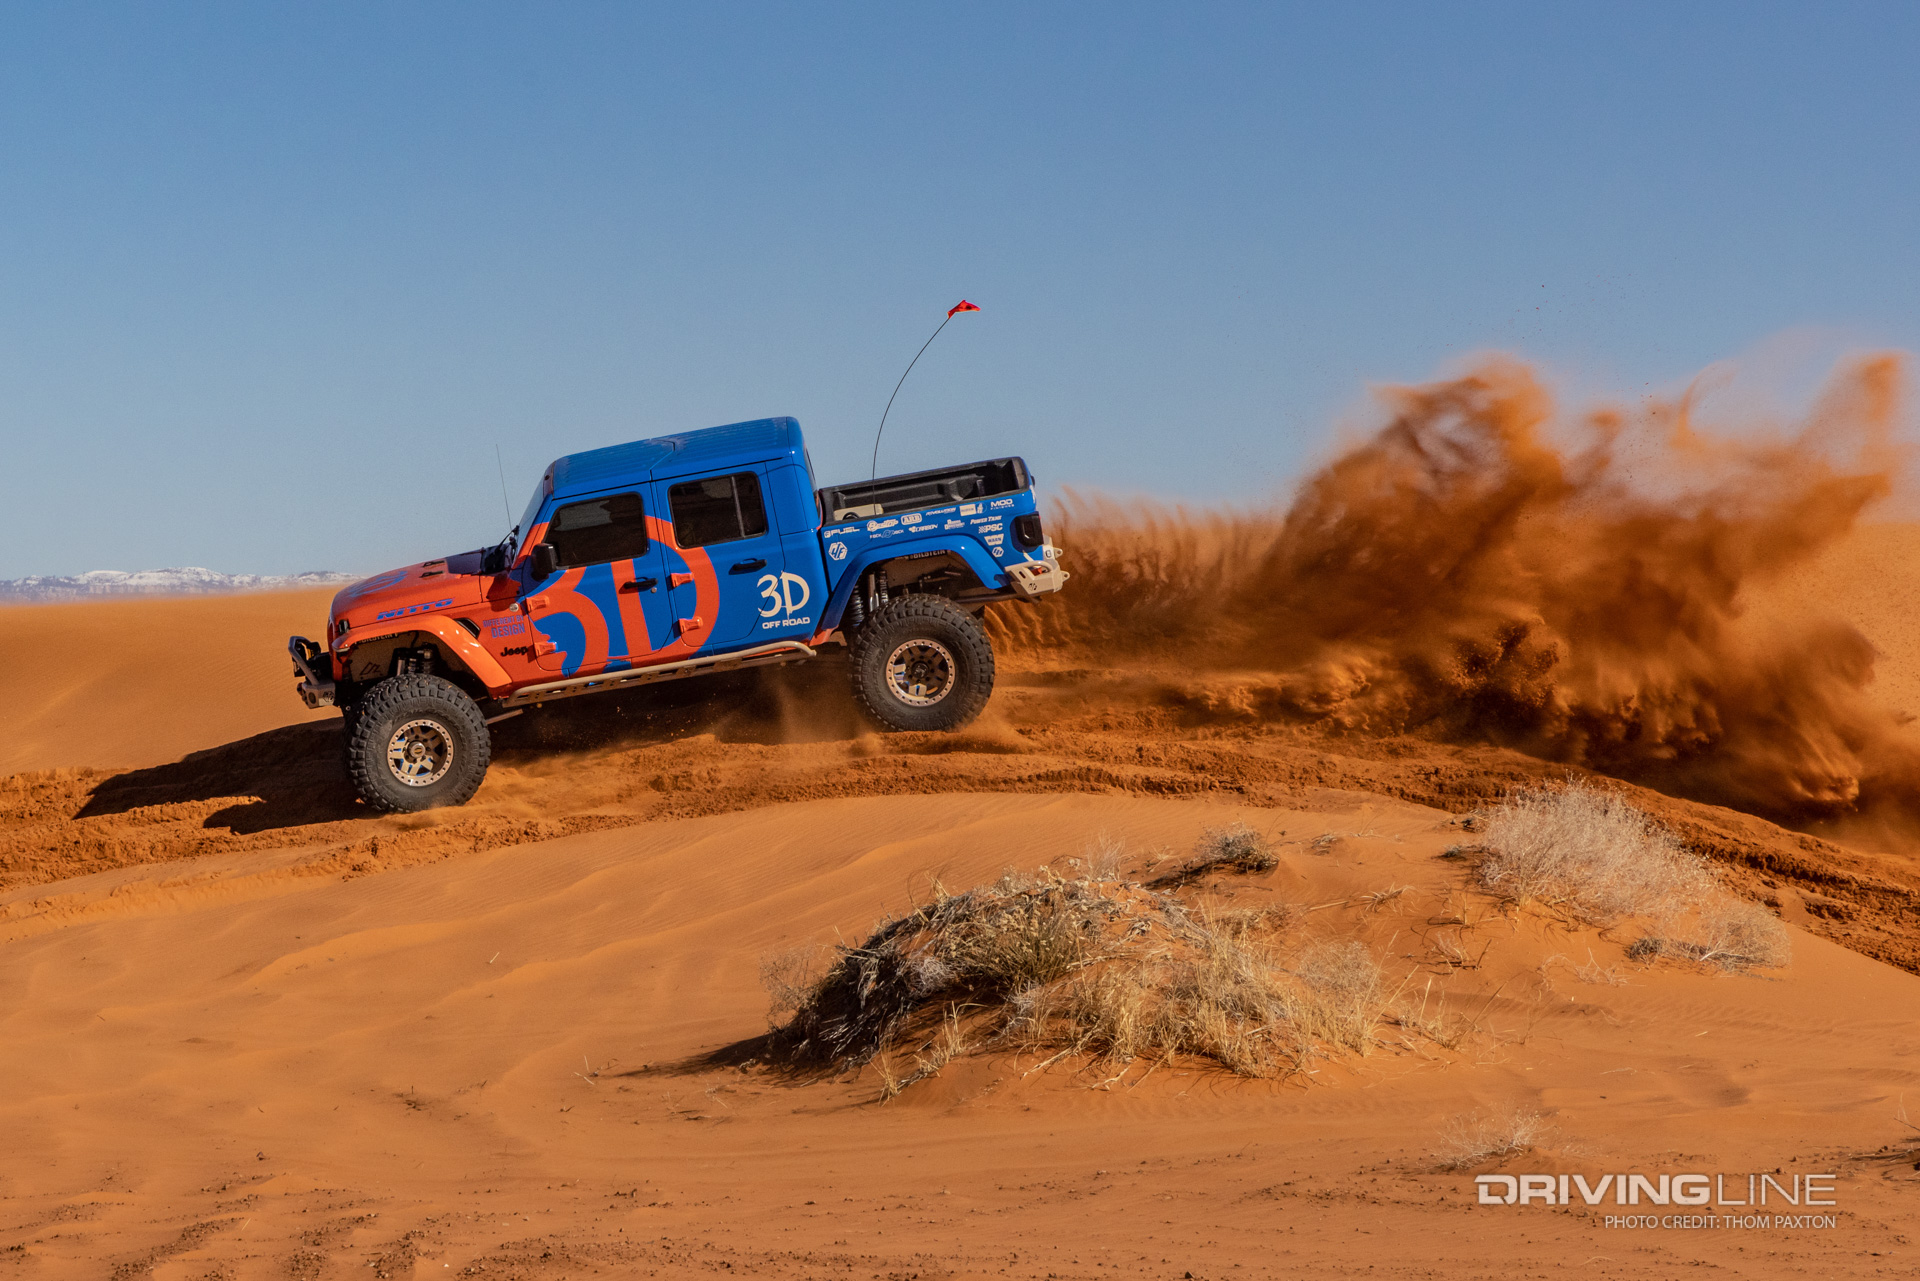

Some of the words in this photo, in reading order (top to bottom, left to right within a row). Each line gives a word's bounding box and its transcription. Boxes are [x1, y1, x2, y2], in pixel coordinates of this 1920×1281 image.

[990, 498, 1013, 507] MOD
[985, 522, 1004, 533] PSC
[757, 571, 810, 621] 3D
[376, 597, 456, 621] NITTO
[483, 615, 515, 628] DIFFERENT
[516, 614, 525, 623] BY
[762, 620, 780, 630] OFF
[781, 616, 810, 627] ROAD
[491, 623, 526, 639] DESIGN
[500, 646, 528, 657] Jeep
